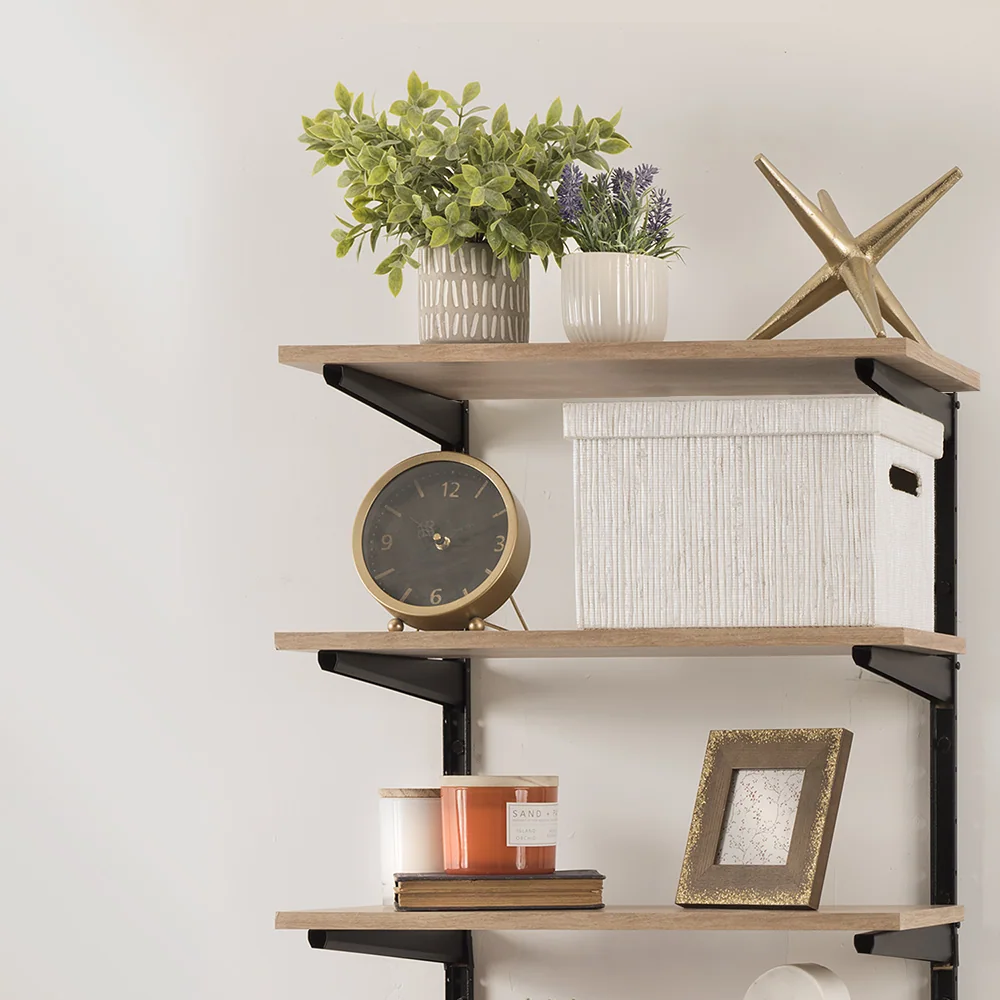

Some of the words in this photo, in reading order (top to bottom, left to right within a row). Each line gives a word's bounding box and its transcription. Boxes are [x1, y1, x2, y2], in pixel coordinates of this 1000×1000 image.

[441, 481, 461, 498] 12
[381, 534, 393, 551] 9
[493, 535, 505, 552] 3
[429, 588, 443, 605] 6
[512, 809, 542, 818] SAND
